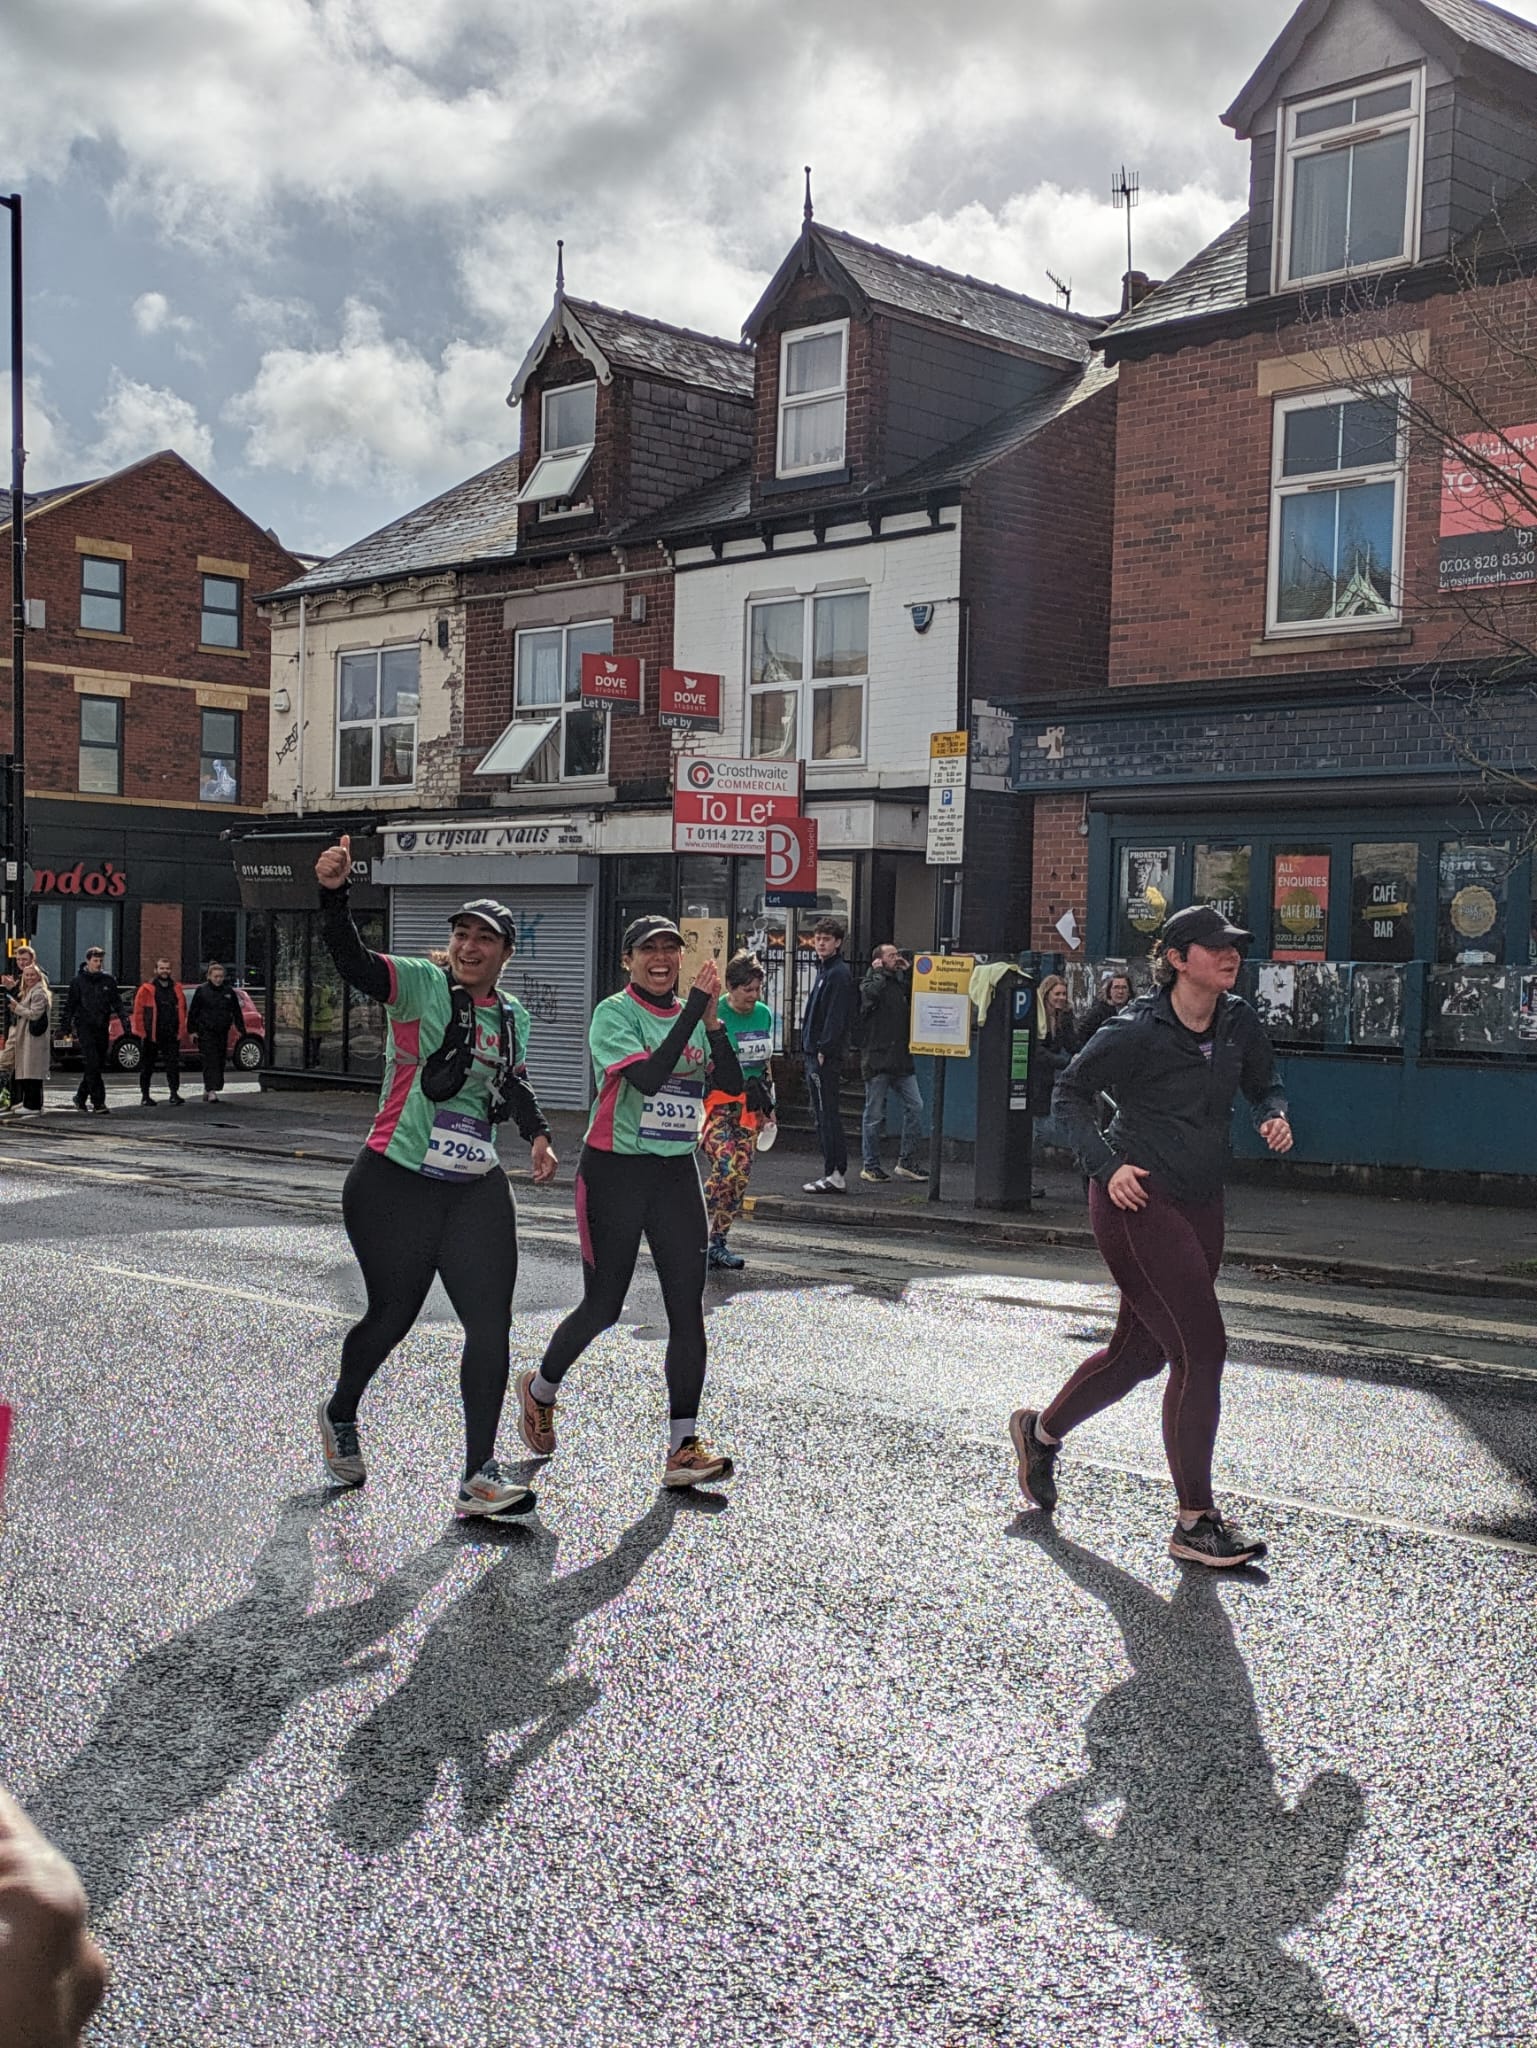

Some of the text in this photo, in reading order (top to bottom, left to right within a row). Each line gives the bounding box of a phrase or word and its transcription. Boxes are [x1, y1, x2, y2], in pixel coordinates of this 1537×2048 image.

[1444, 472, 1478, 494] TO
[1440, 551, 1534, 574] 0203 828 8530
[595, 675, 628, 688] DOVE
[583, 697, 599, 708] Let
[601, 699, 614, 711] by
[674, 691, 707, 705] DOVE
[662, 715, 677, 726] Let
[680, 717, 693, 728] by
[717, 763, 788, 780] Crosthwaite
[717, 778, 788, 792] COMMERCIAL
[696, 794, 776, 824] To Let
[424, 827, 550, 850] Crystal Nails
[686, 827, 693, 839] T
[697, 828, 726, 841] 0114
[731, 829, 754, 842] 272
[1130, 851, 1168, 859] PHONETICS
[241, 865, 259, 876] 0114
[1279, 863, 1294, 873] ALL
[32, 861, 127, 896] ndo's
[1278, 876, 1328, 887] ENQUIRIES
[1373, 881, 1398, 902] CAFÉ
[1373, 920, 1394, 938] BAR
[1016, 991, 1026, 1014] P
[656, 1101, 696, 1119] 3812
[442, 1139, 486, 1162] 2962
